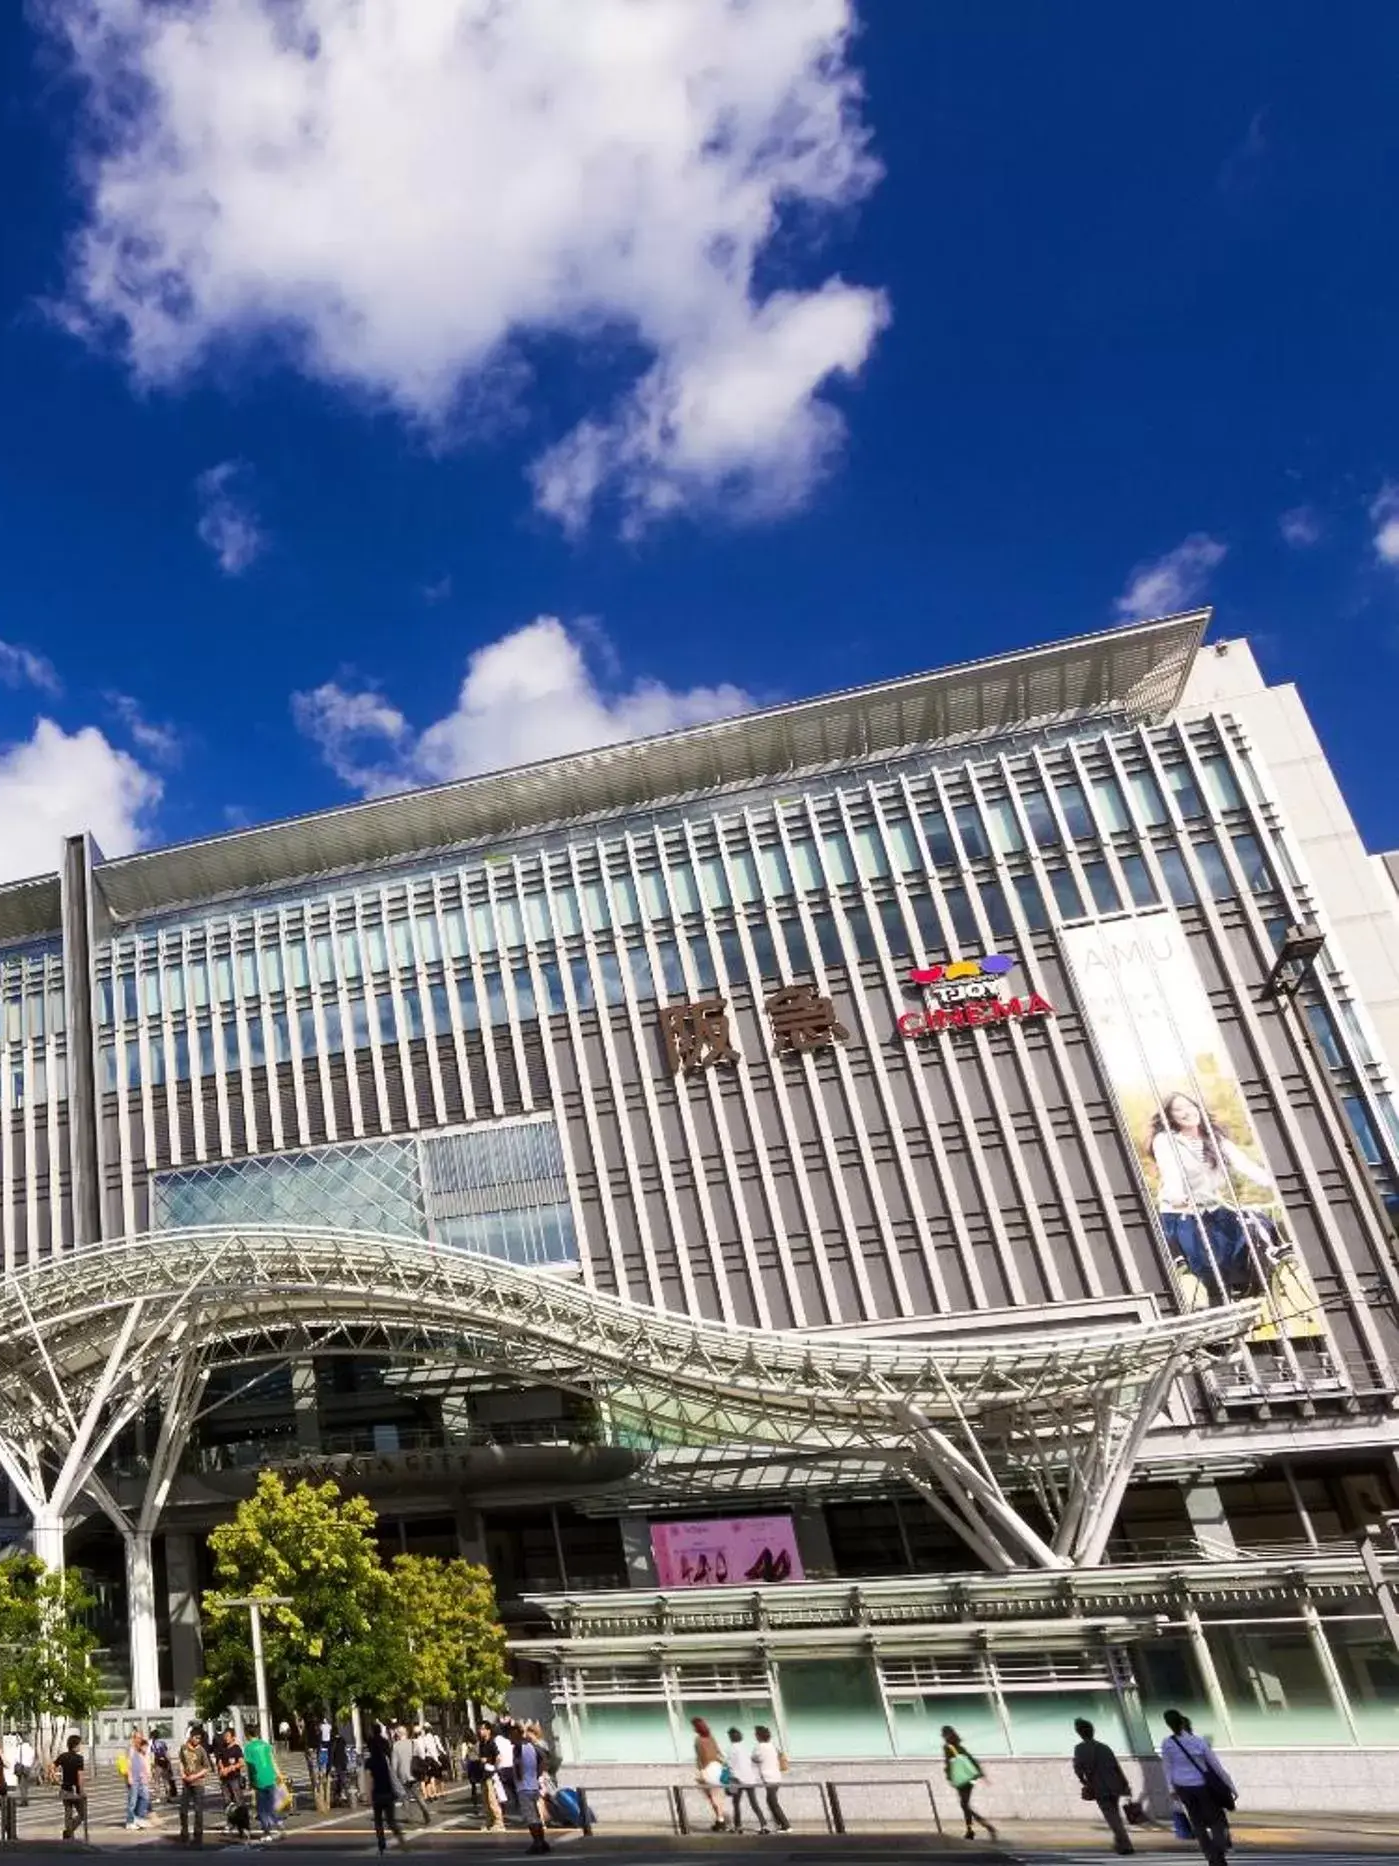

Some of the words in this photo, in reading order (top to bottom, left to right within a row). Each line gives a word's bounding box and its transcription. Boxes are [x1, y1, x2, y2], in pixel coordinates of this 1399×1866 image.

[1084, 934, 1173, 974] AMU
[660, 985, 849, 1077] 阪急
[897, 992, 1056, 1039] CINEMA
